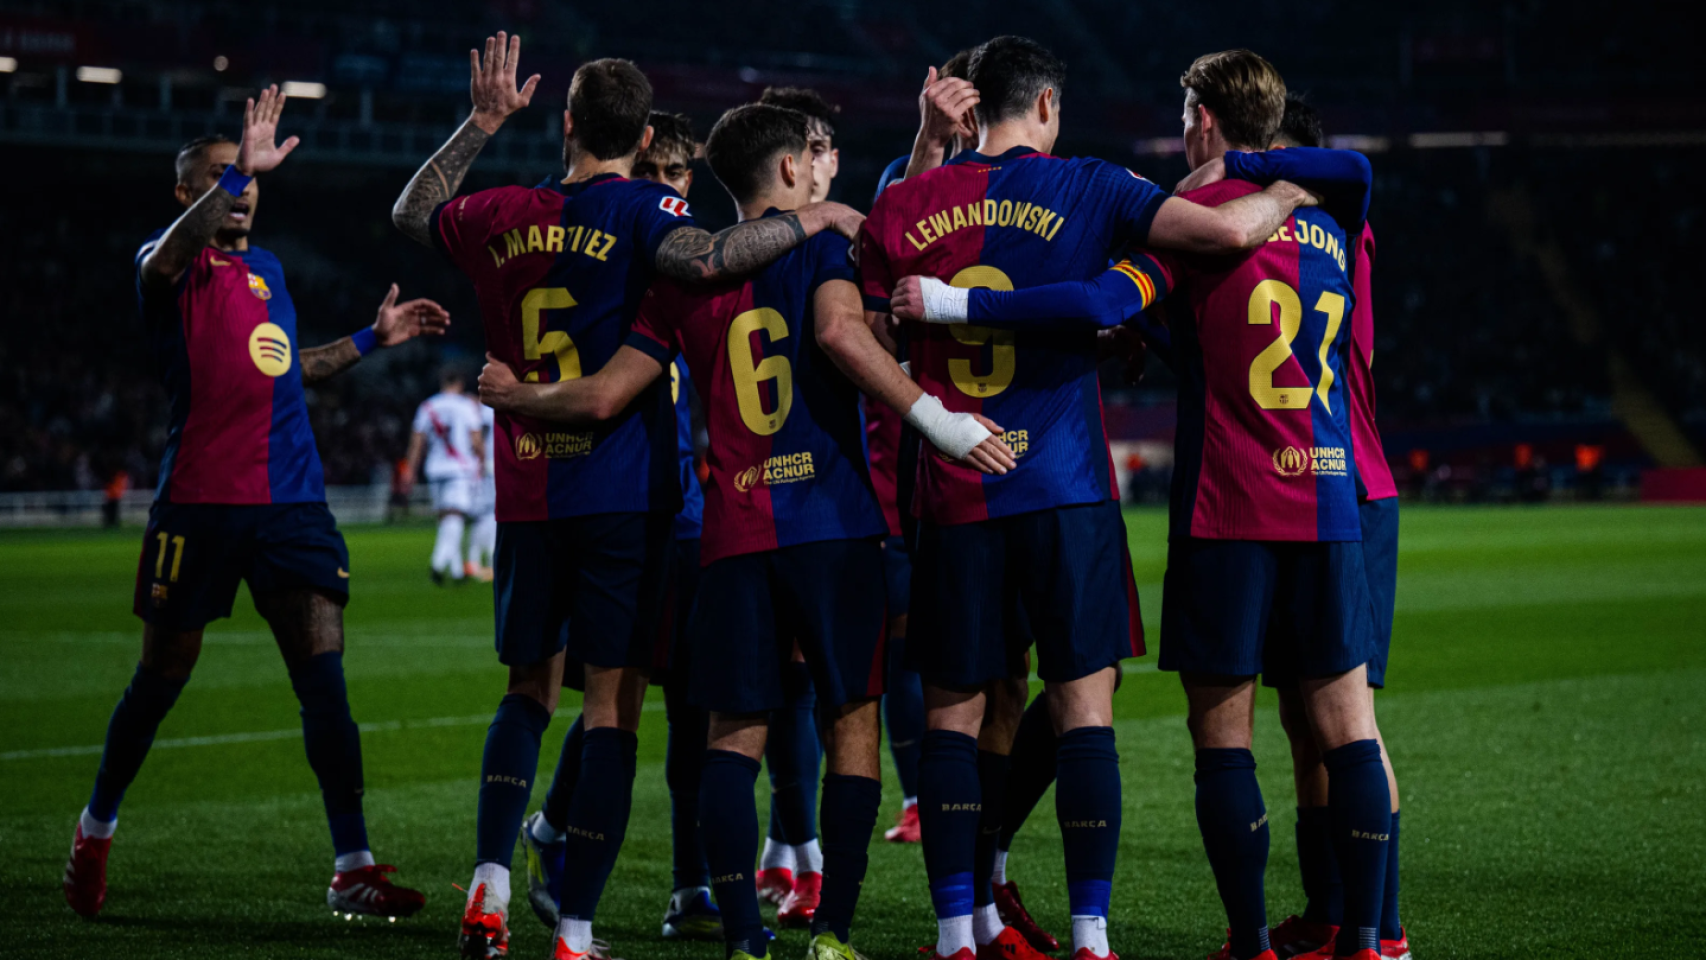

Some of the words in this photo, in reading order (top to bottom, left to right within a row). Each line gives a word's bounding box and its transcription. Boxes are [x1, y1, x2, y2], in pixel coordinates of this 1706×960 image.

[904, 198, 1065, 252] LEWANDOWSKI
[1293, 218, 1346, 272] JONG
[520, 286, 583, 383] 5
[947, 264, 1017, 399] 9
[1247, 278, 1346, 418] 21
[726, 306, 794, 436] 6
[546, 440, 592, 454] ACNUR
[763, 451, 813, 469] UNHCR
[763, 463, 815, 480] ACNUR
[1309, 446, 1346, 460] UNHCR
[1311, 458, 1348, 472] ACNUR
[154, 529, 187, 583] 11
